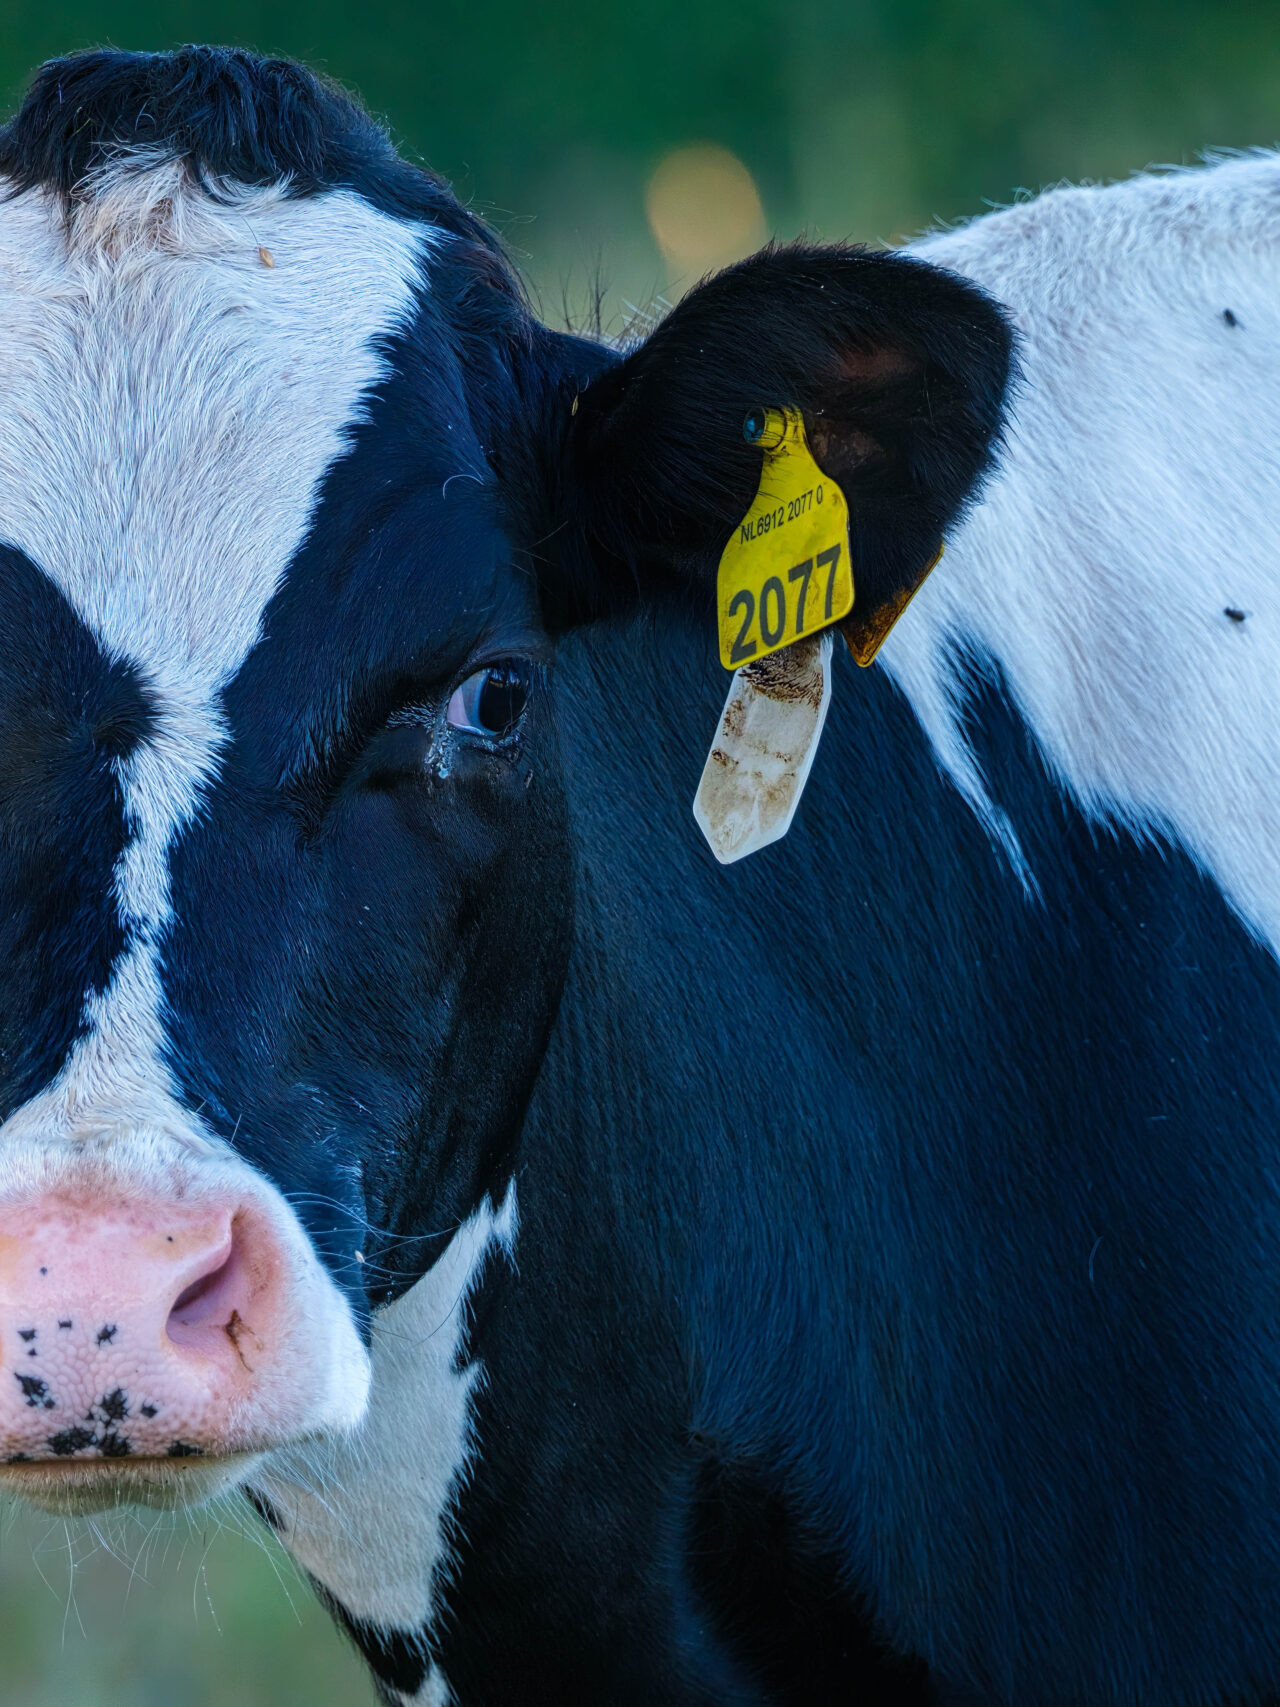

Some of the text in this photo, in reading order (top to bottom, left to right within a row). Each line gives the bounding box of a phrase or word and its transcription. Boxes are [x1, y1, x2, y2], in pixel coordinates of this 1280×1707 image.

[740, 485, 823, 544] NL6912 2077 0
[728, 543, 841, 665] 2077
